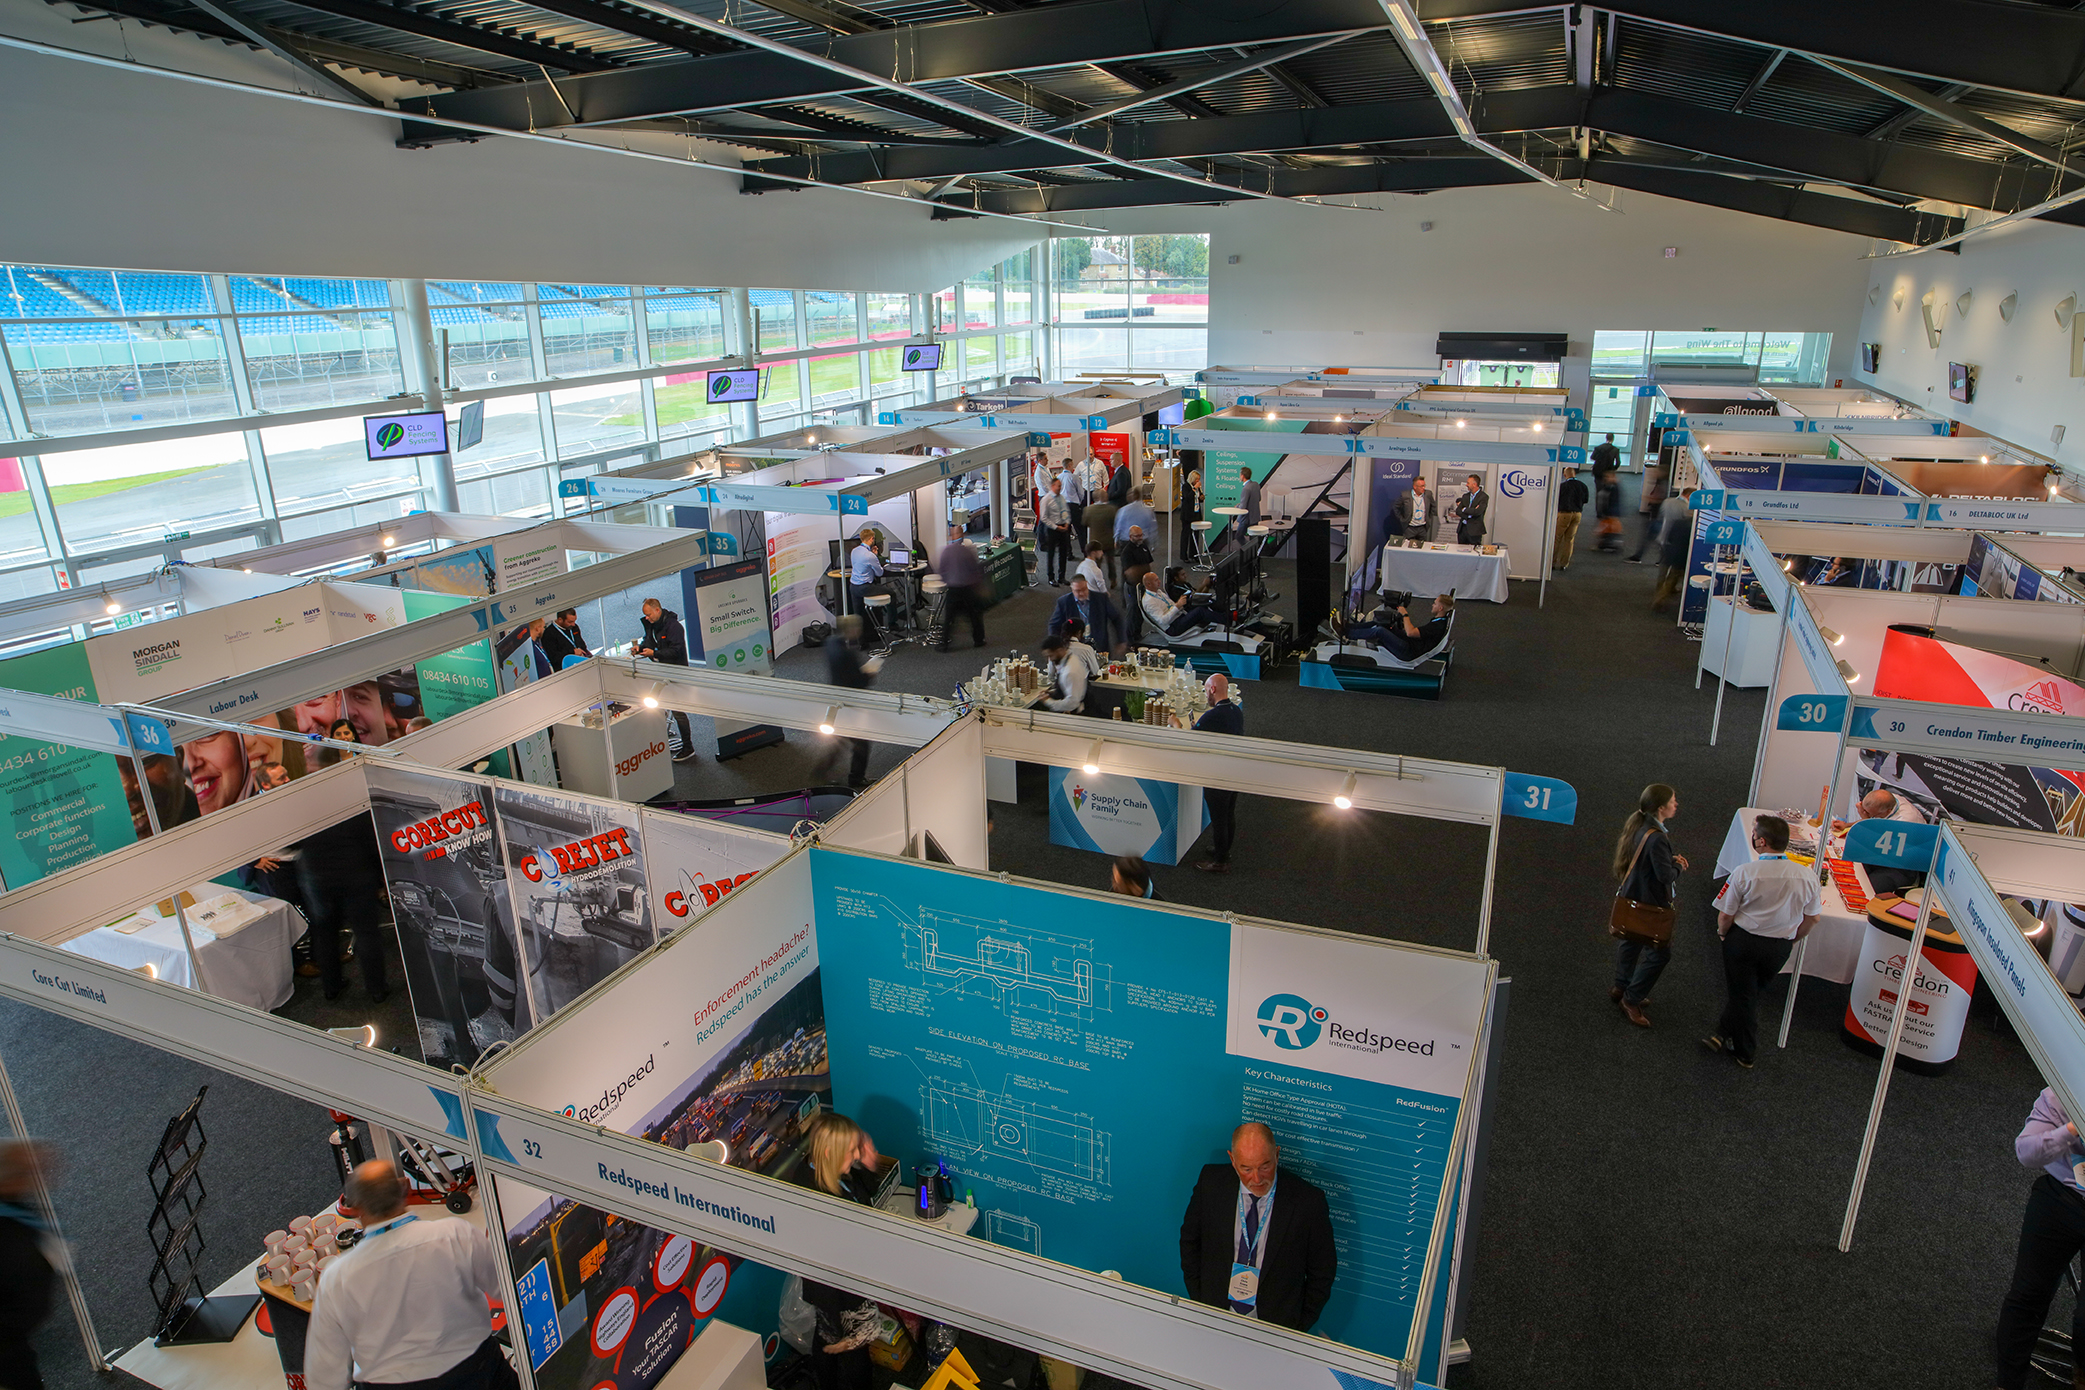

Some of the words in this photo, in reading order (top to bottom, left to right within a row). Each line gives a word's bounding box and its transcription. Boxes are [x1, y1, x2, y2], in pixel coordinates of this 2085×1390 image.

[976, 402, 1004, 410] Tarkett
[1574, 421, 1583, 430] 19
[1036, 436, 1045, 444] 23
[1154, 433, 1164, 441] 22
[1671, 434, 1680, 443] 17
[1567, 450, 1578, 459] 20
[1714, 465, 1760, 473] GRUNDFOS
[566, 483, 579, 494] 26
[1516, 475, 1546, 488] Ideal
[848, 500, 859, 510] 24
[1701, 494, 1713, 505] 18
[1762, 501, 1787, 509] Grundfos
[1968, 510, 2005, 519] DELTABLOC
[2017, 512, 2029, 520] Ltd
[1717, 526, 1733, 539] 29
[715, 537, 729, 550] 35
[503, 553, 525, 564] Greener
[525, 544, 558, 558] construction
[504, 562, 518, 570] from
[519, 556, 541, 567] Aggreko
[303, 607, 321, 617] HAYS
[508, 604, 517, 614] 35
[535, 592, 556, 606] Aggreko
[116, 615, 129, 625] Fire
[710, 614, 730, 624] Small
[731, 606, 757, 619] Switch.
[710, 625, 722, 634] Big
[723, 615, 762, 631] Difference.
[132, 639, 181, 659] MORGAN
[135, 649, 180, 668] SINDALL
[137, 665, 163, 677] GROUP
[422, 669, 451, 683] 08434
[452, 673, 469, 686] 610
[471, 676, 489, 689] 105
[209, 698, 237, 715] Labour
[239, 690, 260, 705] Desk
[1798, 702, 1827, 723] 30
[141, 724, 160, 745] 36
[1889, 721, 1906, 733] 30
[1926, 724, 1973, 740] Crendon
[1977, 729, 2017, 743] Timber
[614, 741, 666, 776] aggreko
[10, 798, 51, 817] POSITIONS
[52, 792, 64, 803] WE
[65, 787, 82, 799] HIRE
[1091, 793, 1121, 807] Supply
[1123, 798, 1148, 810] Chain
[1523, 786, 1551, 810] 31
[30, 797, 86, 822] Commercial
[1091, 803, 1119, 816] Family
[15, 817, 63, 841] Corporate
[64, 802, 106, 822] functions
[390, 800, 489, 854] CORECUT
[49, 824, 82, 841] Design
[444, 835, 473, 856] KNOW
[470, 828, 493, 848] HOW
[48, 833, 89, 854] Planning
[1874, 830, 1908, 857] 41
[46, 842, 97, 866] Production
[570, 857, 637, 885] HYDRODEMOLITION
[1948, 869, 1956, 885] 41
[1966, 897, 1987, 937] Kingspan
[1986, 927, 2009, 971] Insulated
[2007, 955, 2026, 998] Panels
[694, 964, 760, 1027] Enforcement
[760, 923, 811, 973] headache?
[32, 969, 54, 987] Core
[55, 976, 71, 993] Cut
[72, 981, 107, 1005] Limited
[695, 1000, 745, 1046] Redspeed
[745, 986, 763, 1004] has
[763, 971, 779, 989] the
[779, 944, 811, 977] answer
[1867, 1000, 1882, 1011] Ask
[1919, 1020, 1935, 1029] our
[1329, 1022, 1434, 1057] Redspeed
[1863, 1021, 1888, 1035] Better
[1900, 1035, 1929, 1050] Design
[928, 1026, 945, 1035] SIDE
[948, 1030, 989, 1046] ELEVATION
[992, 1041, 1003, 1050] ON
[1008, 1045, 1050, 1061] PROPOSED
[1053, 1055, 1065, 1065] RC
[1069, 1059, 1090, 1070] BASE
[1329, 1039, 1379, 1055] International
[579, 1053, 656, 1124] Redspeed
[1244, 1067, 1262, 1079] Key
[1263, 1070, 1334, 1092] Characteristics
[1300, 1097, 1326, 1106] Approval
[523, 1138, 543, 1160] 32
[597, 1162, 670, 1201] Redspeed
[674, 1186, 777, 1234] International
[963, 1167, 980, 1177] VIEW
[983, 1173, 994, 1182] ON
[997, 1176, 1038, 1193] PROPOSED
[1040, 1188, 1052, 1197] RC
[1055, 1192, 1075, 1203] BASE
[542, 1318, 554, 1334] 15
[543, 1328, 556, 1344] 44
[545, 1338, 558, 1354] 58
[632, 1353, 651, 1377] Your
[650, 1322, 679, 1357] TASCAR
[641, 1343, 673, 1380] Solution
